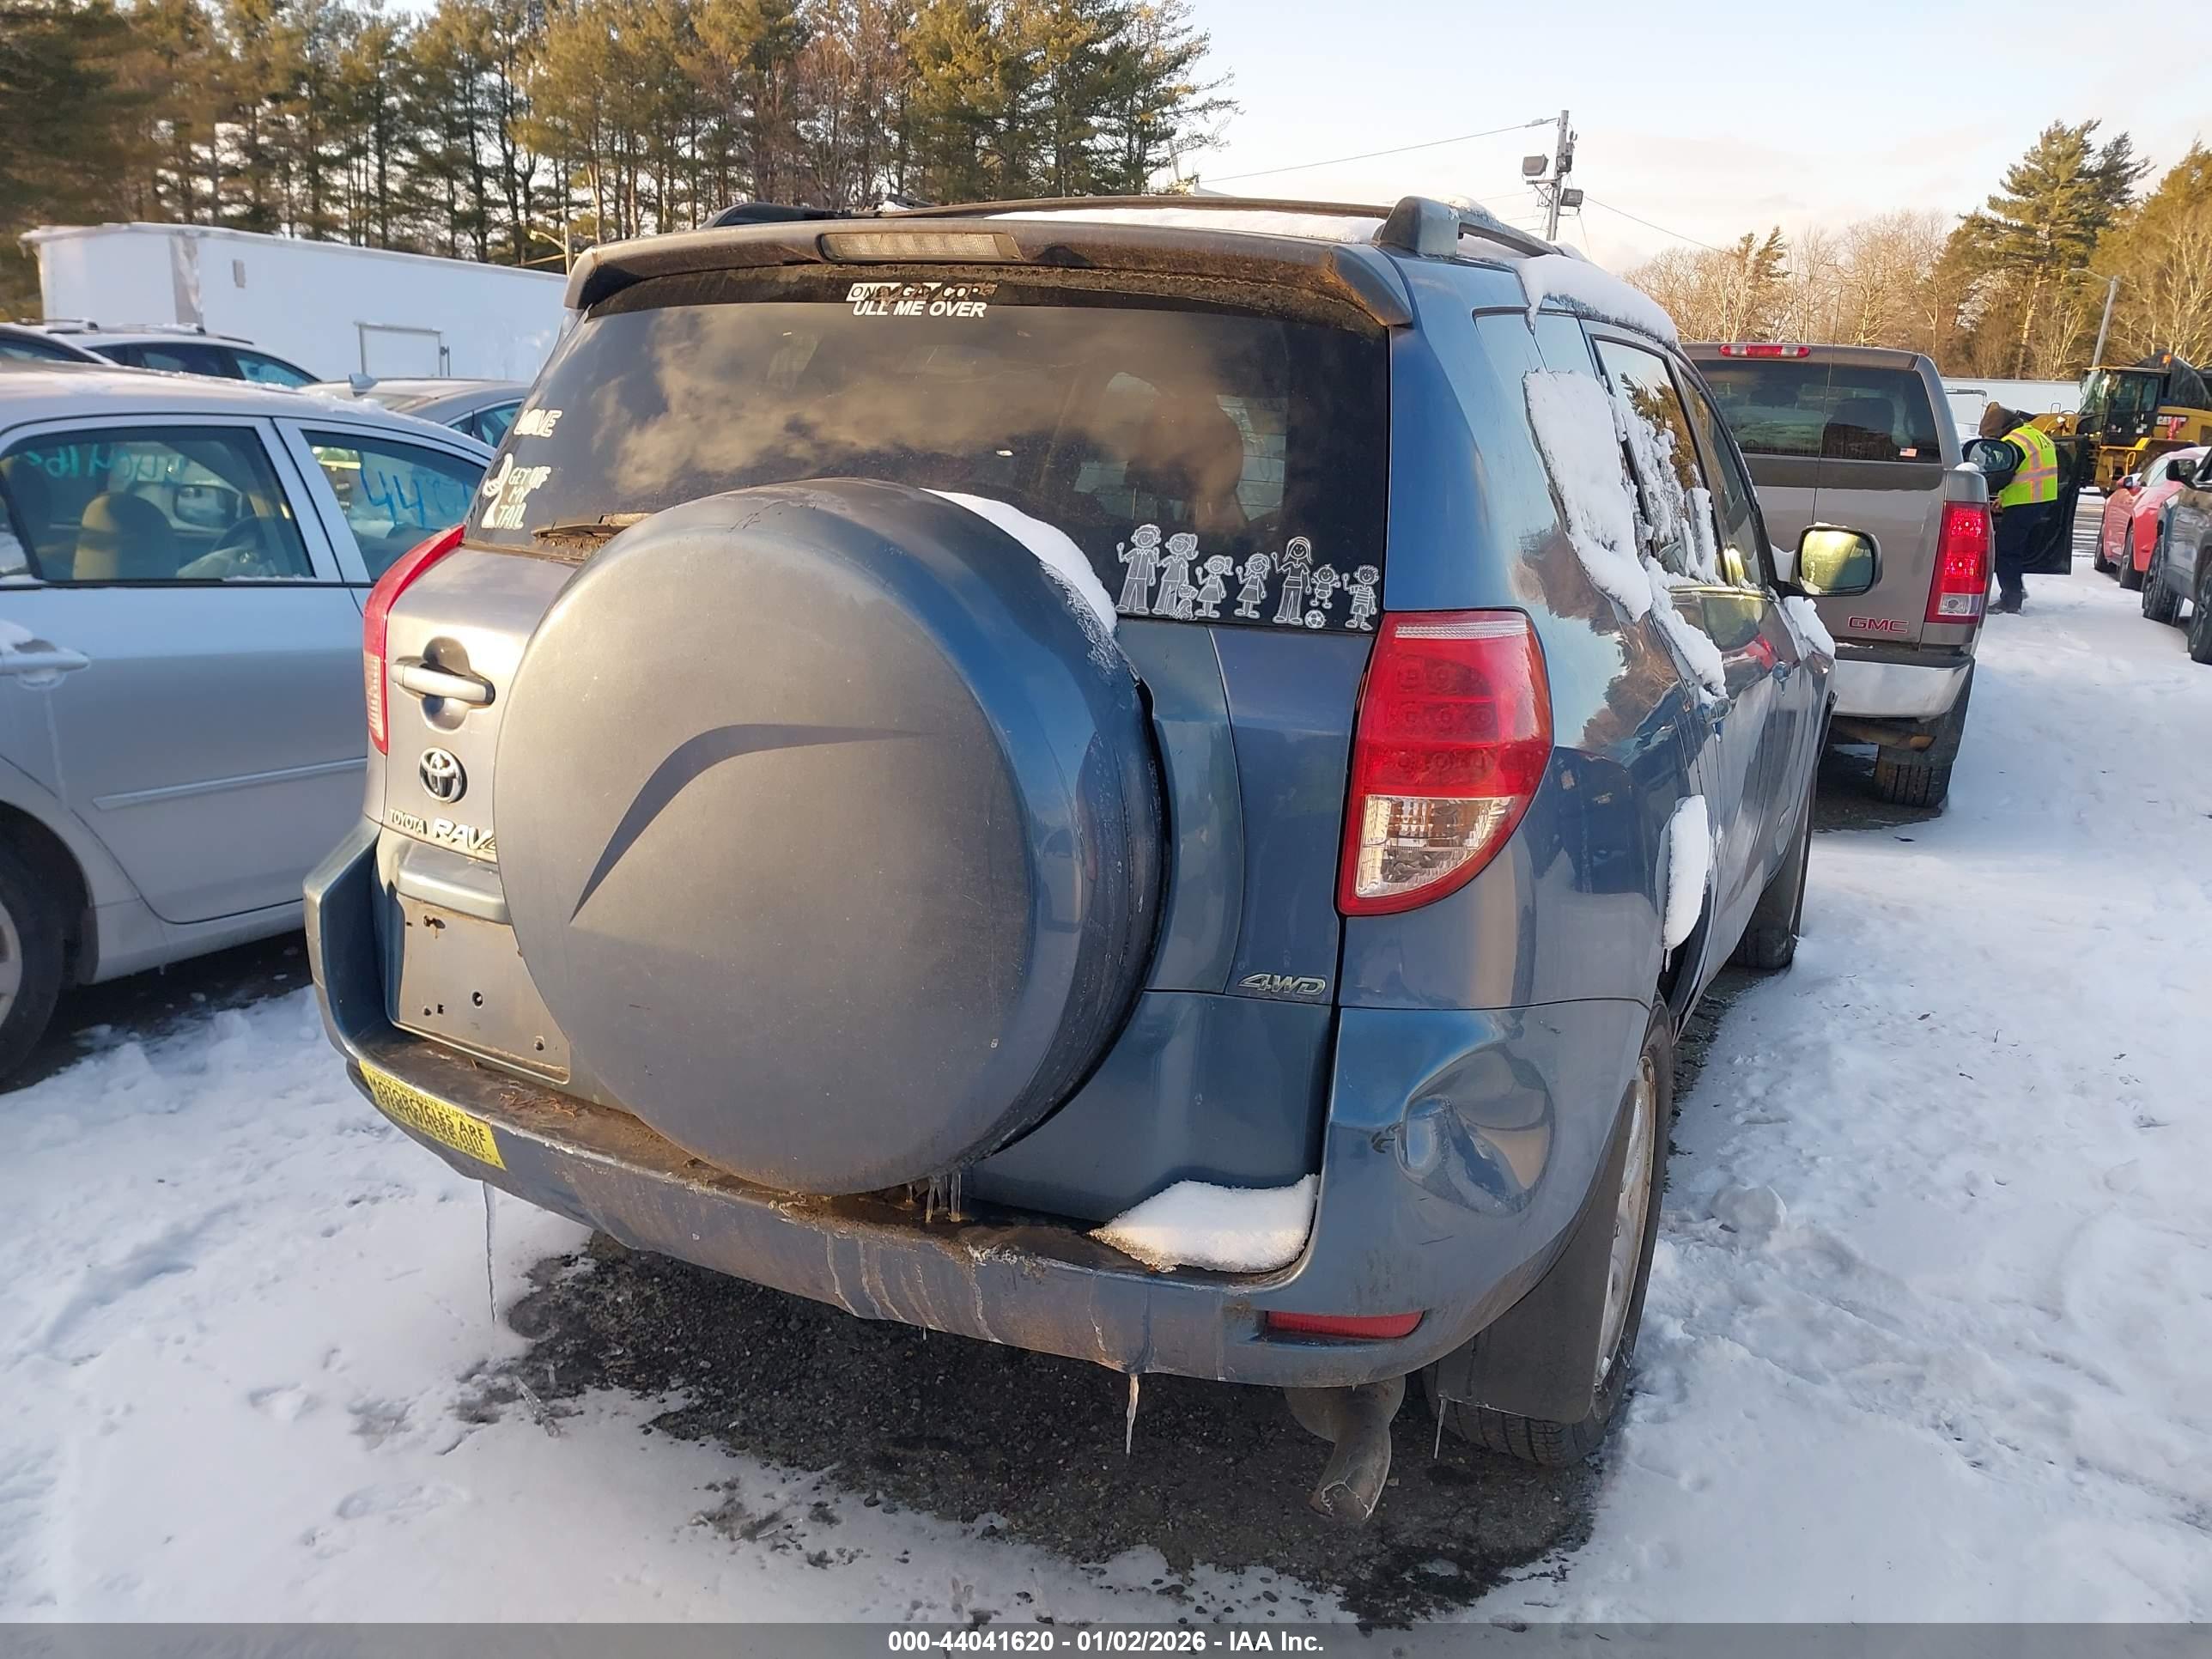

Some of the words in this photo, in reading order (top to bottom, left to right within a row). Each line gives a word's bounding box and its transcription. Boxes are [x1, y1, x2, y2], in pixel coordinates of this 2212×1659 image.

[893, 301, 923, 316] ME
[929, 301, 987, 317] OVER
[508, 467, 532, 485] GET
[508, 486, 531, 503] MY
[496, 502, 526, 530] TAIL
[1848, 616, 1909, 633] GMC
[389, 809, 428, 835] TOYOTA
[1237, 973, 1326, 995] 4WD
[367, 1075, 454, 1129] MOTORCYCLES
[459, 1120, 486, 1142] ARE
[378, 1090, 456, 1140] EVERYWHERE
